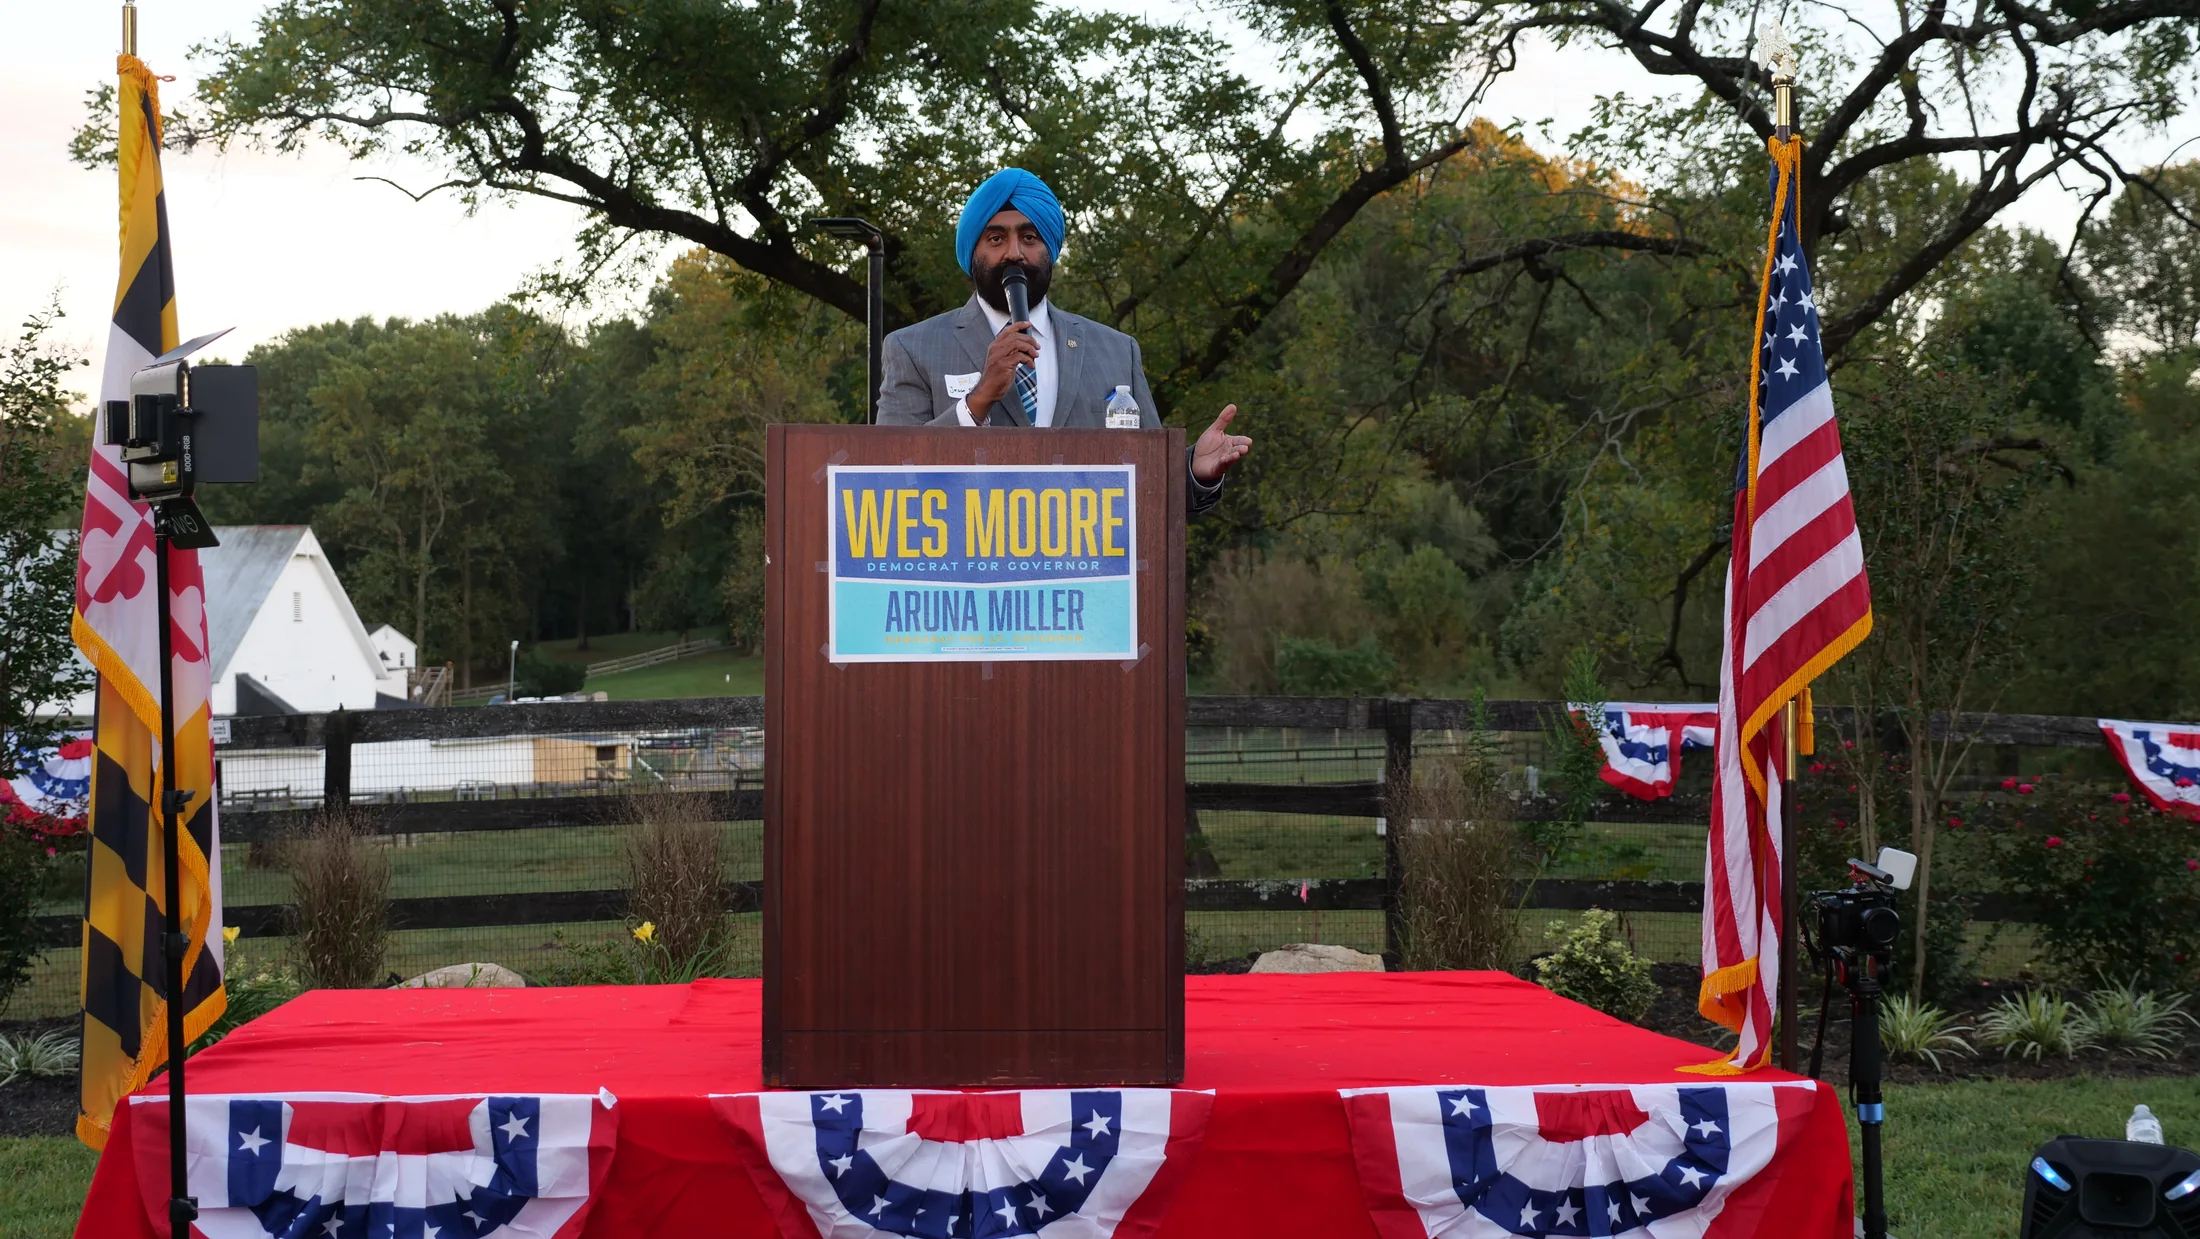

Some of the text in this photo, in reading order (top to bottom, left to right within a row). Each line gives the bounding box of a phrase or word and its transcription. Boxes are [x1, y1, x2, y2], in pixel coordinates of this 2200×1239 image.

[842, 488, 1126, 559] WES MOORE
[867, 560, 1100, 572] DEMOCRAT FOR GOVERNOR
[885, 589, 1085, 632] ARUNA MILLER
